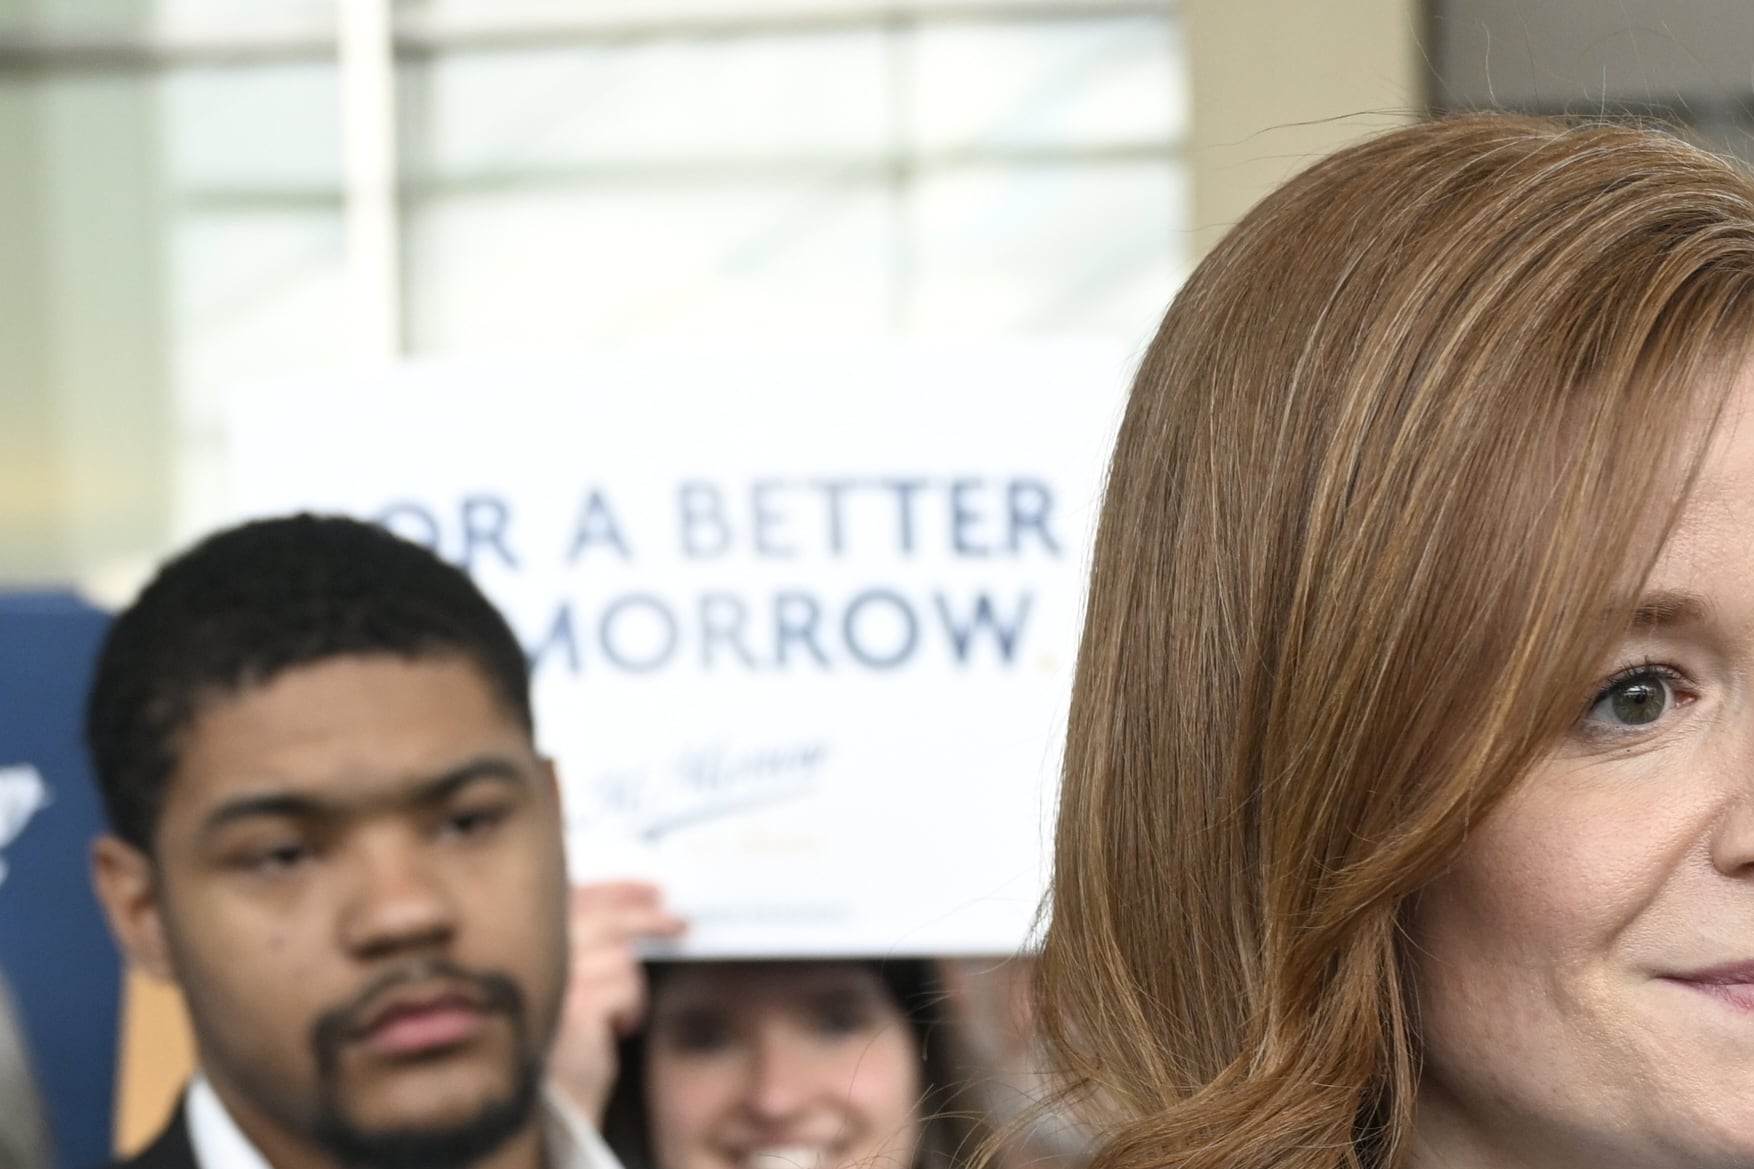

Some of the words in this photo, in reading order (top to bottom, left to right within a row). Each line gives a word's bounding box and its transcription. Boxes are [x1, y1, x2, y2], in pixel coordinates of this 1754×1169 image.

[376, 500, 517, 567] OR
[568, 491, 630, 562] A
[680, 477, 1059, 557] BETTER
[527, 594, 1055, 671] MORROW.
